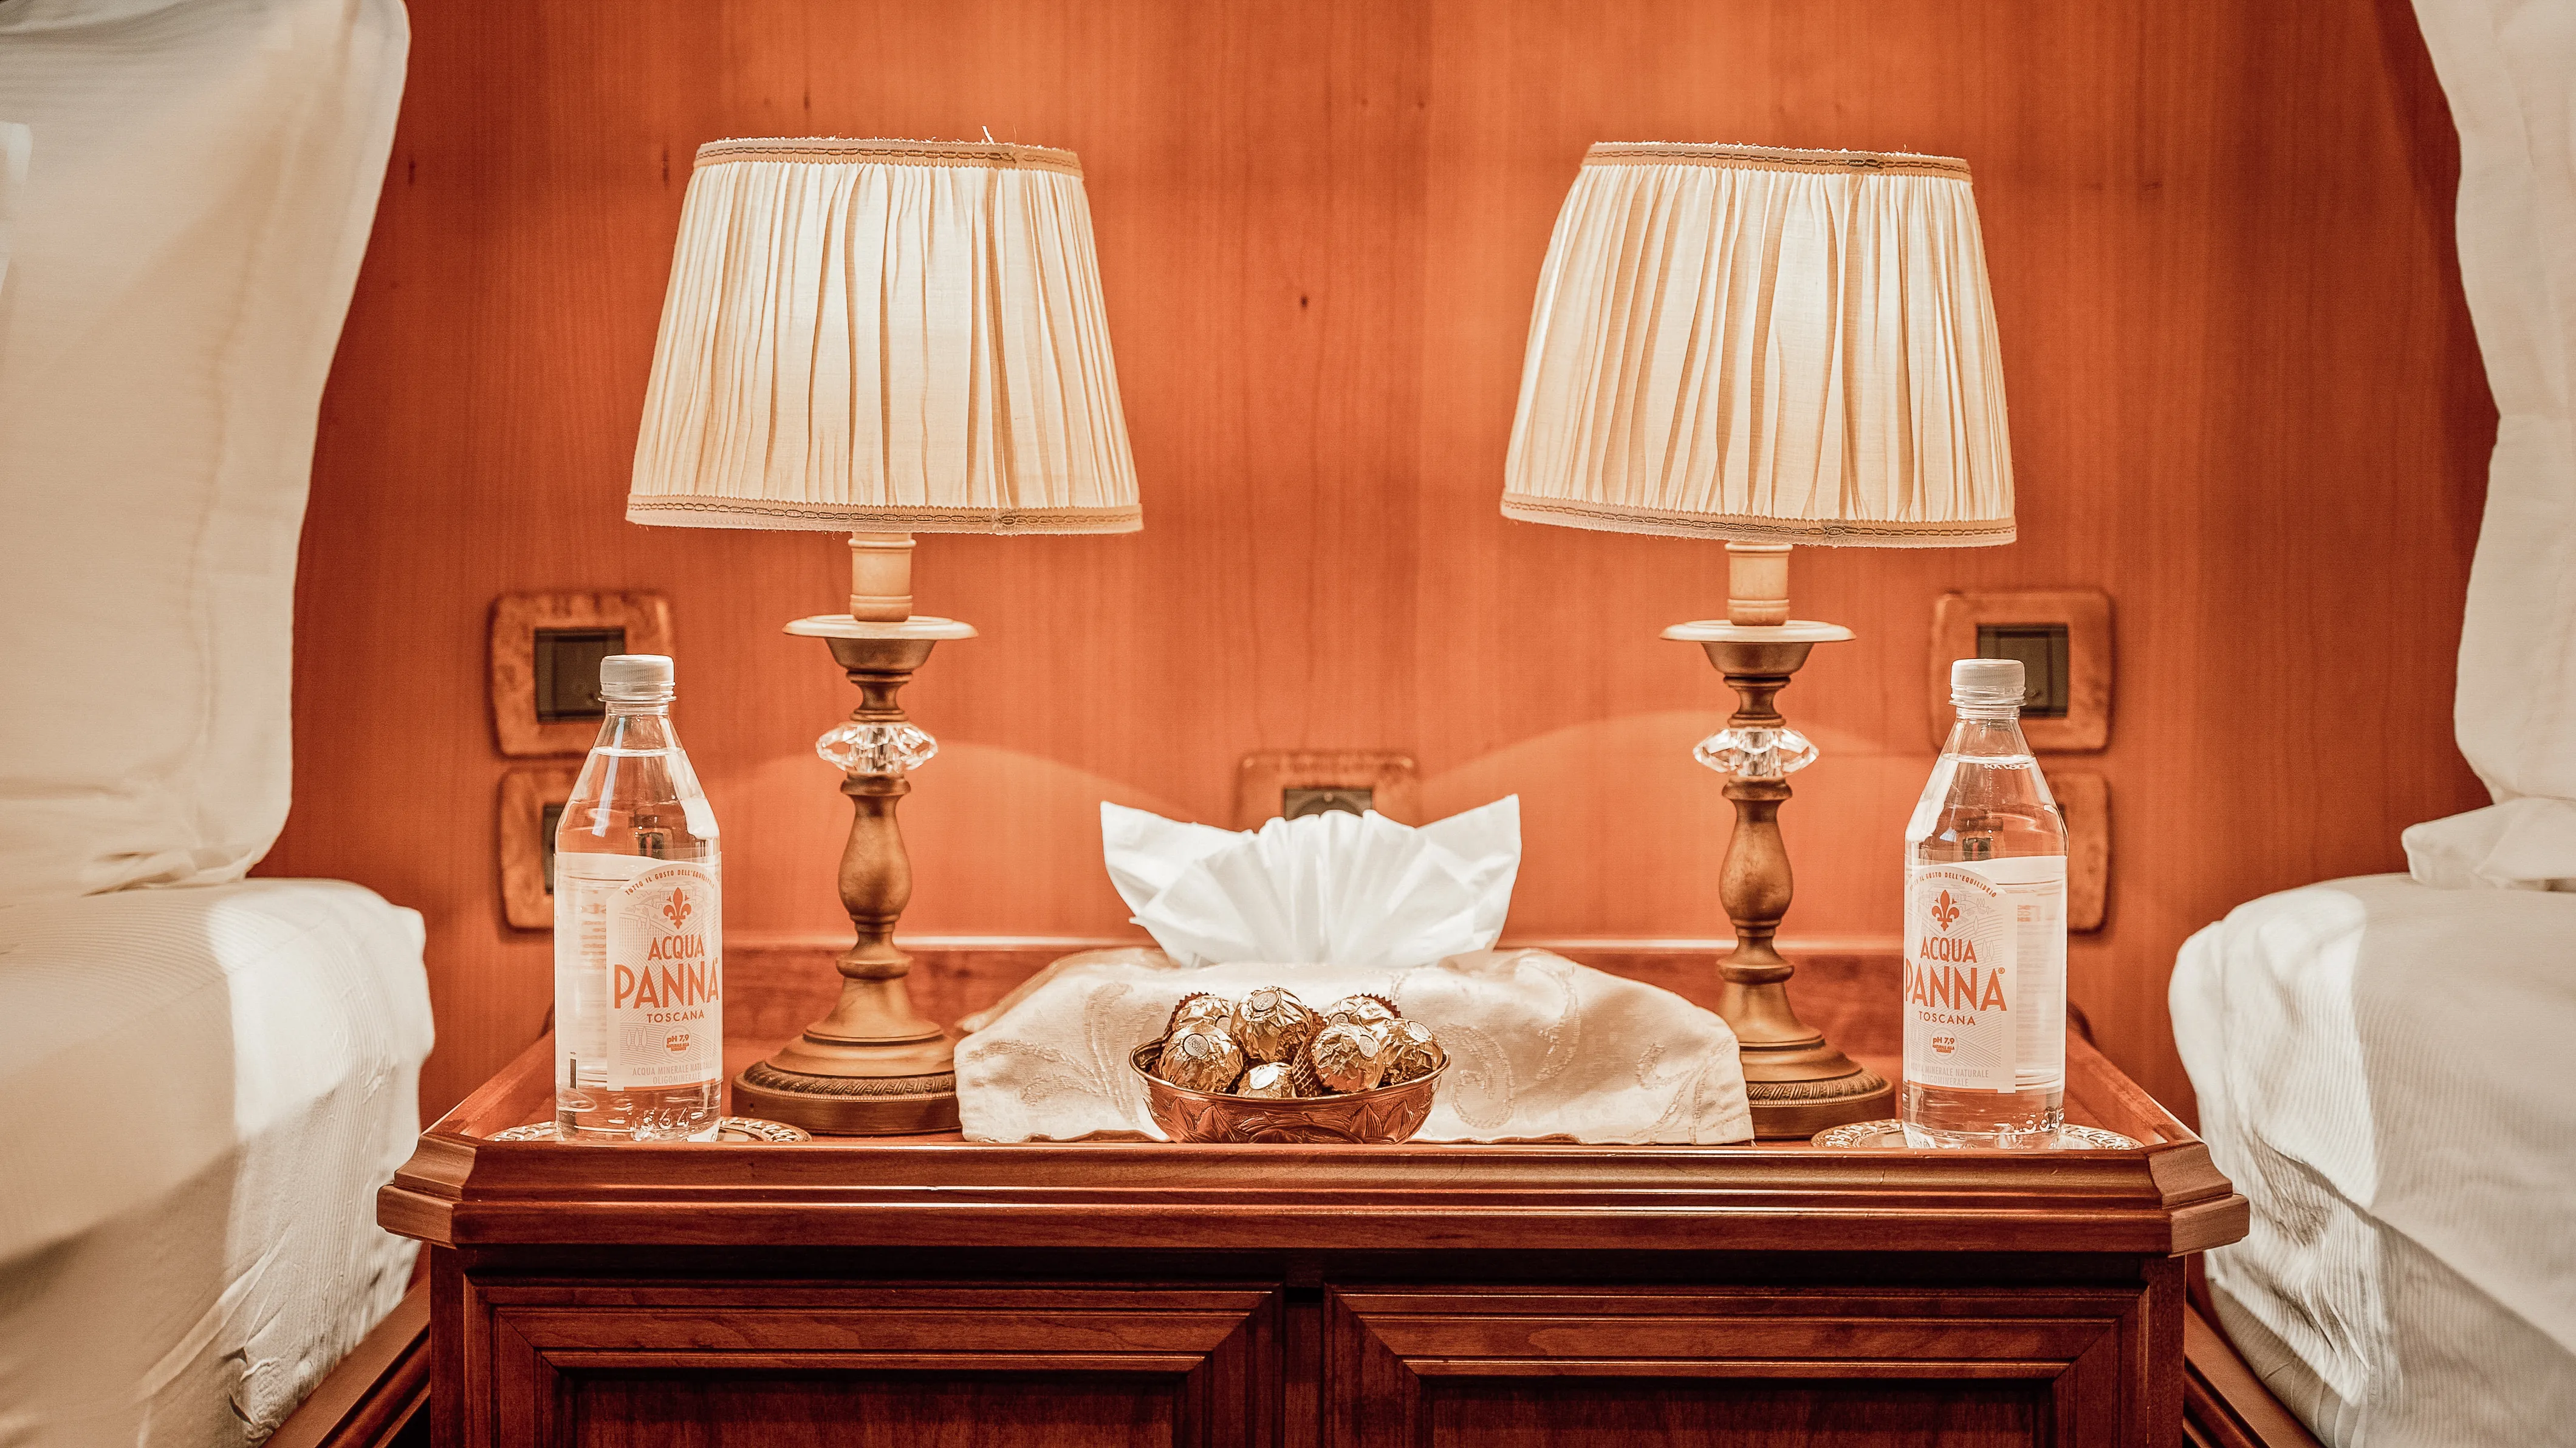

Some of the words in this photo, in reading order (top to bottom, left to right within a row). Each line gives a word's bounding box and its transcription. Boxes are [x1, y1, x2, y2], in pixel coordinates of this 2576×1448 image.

[625, 881, 644, 895] TUTTO
[655, 870, 674, 880] GUSTO
[1945, 872, 1997, 898] DELL'EQUILIBRIO
[648, 934, 705, 961] ACQUA
[1920, 936, 1978, 963] ACQUA
[646, 1009, 705, 1023] TOSCANA
[1919, 1011, 1976, 1026] TOSCANA
[666, 1035, 677, 1044] pH
[679, 1034, 690, 1042] 7,9
[632, 1067, 656, 1076] ACQUA
[657, 1064, 689, 1075] MINERALE
[1925, 1066, 1954, 1076] MINERALE
[1956, 1068, 1989, 1078] NATURALE
[653, 1071, 701, 1084] OLIGOMINERALE
[1921, 1074, 1968, 1087] OLIGOMINERALE
